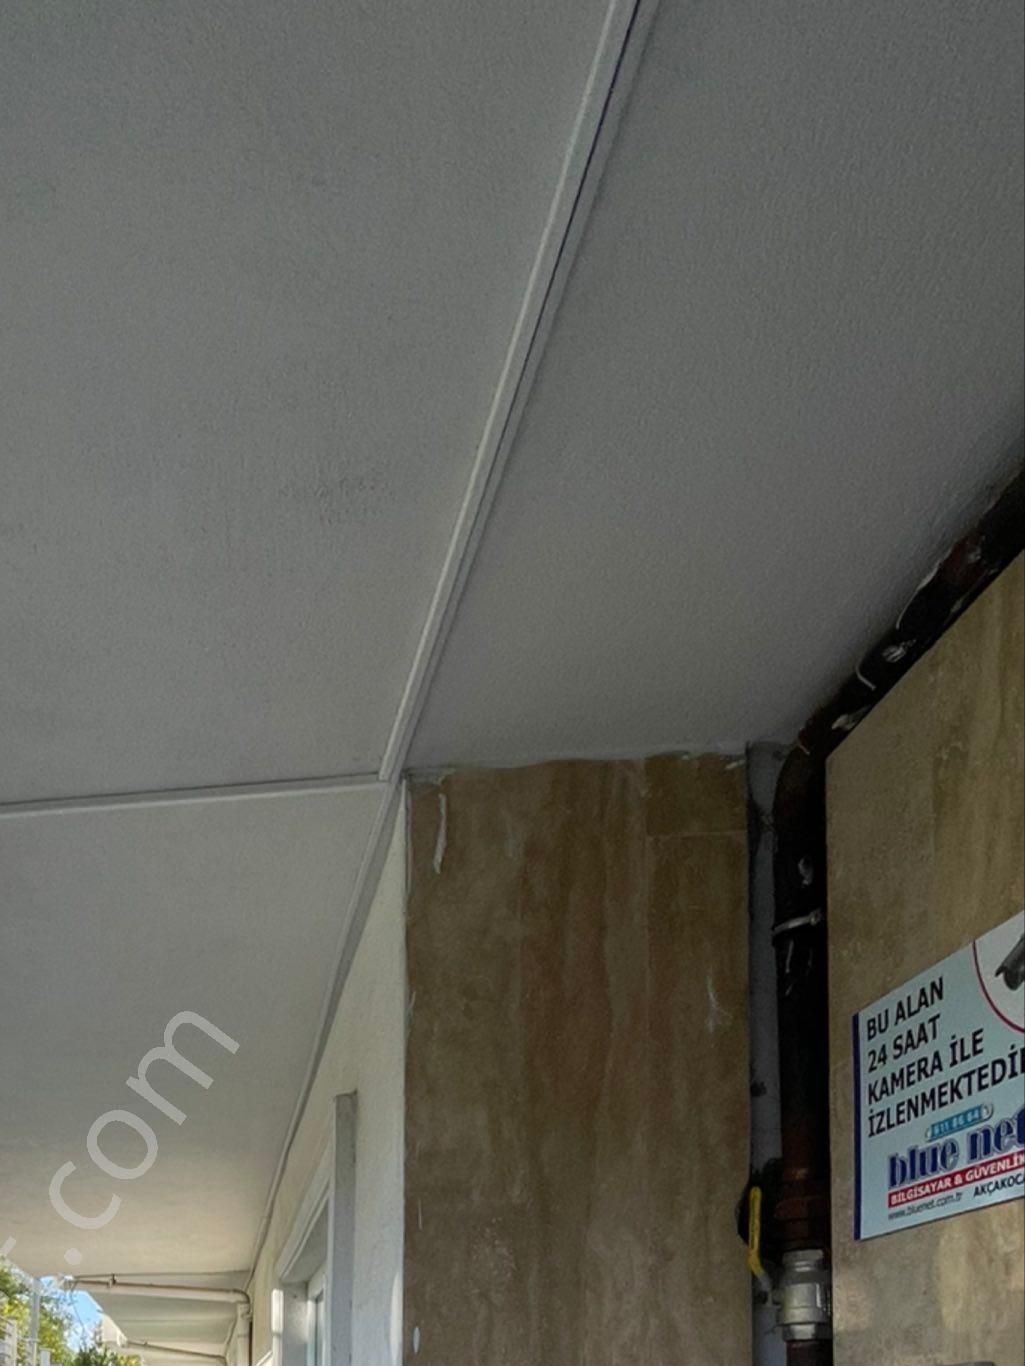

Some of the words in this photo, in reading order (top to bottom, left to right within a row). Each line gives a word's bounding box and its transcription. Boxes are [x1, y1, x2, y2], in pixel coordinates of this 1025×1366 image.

[867, 1009, 889, 1041] BU
[894, 976, 944, 1026] ALAN
[868, 1044, 888, 1073] 24
[893, 1013, 941, 1060] SAAT
[868, 1050, 943, 1105] KAMERA
[950, 1028, 984, 1068] İLE
[889, 1137, 959, 1191] blue
[890, 1177, 951, 1205] BİLGİSAYAR
[953, 1174, 963, 1185] &
[888, 1192, 963, 1220] www.bluenet.com.tr
